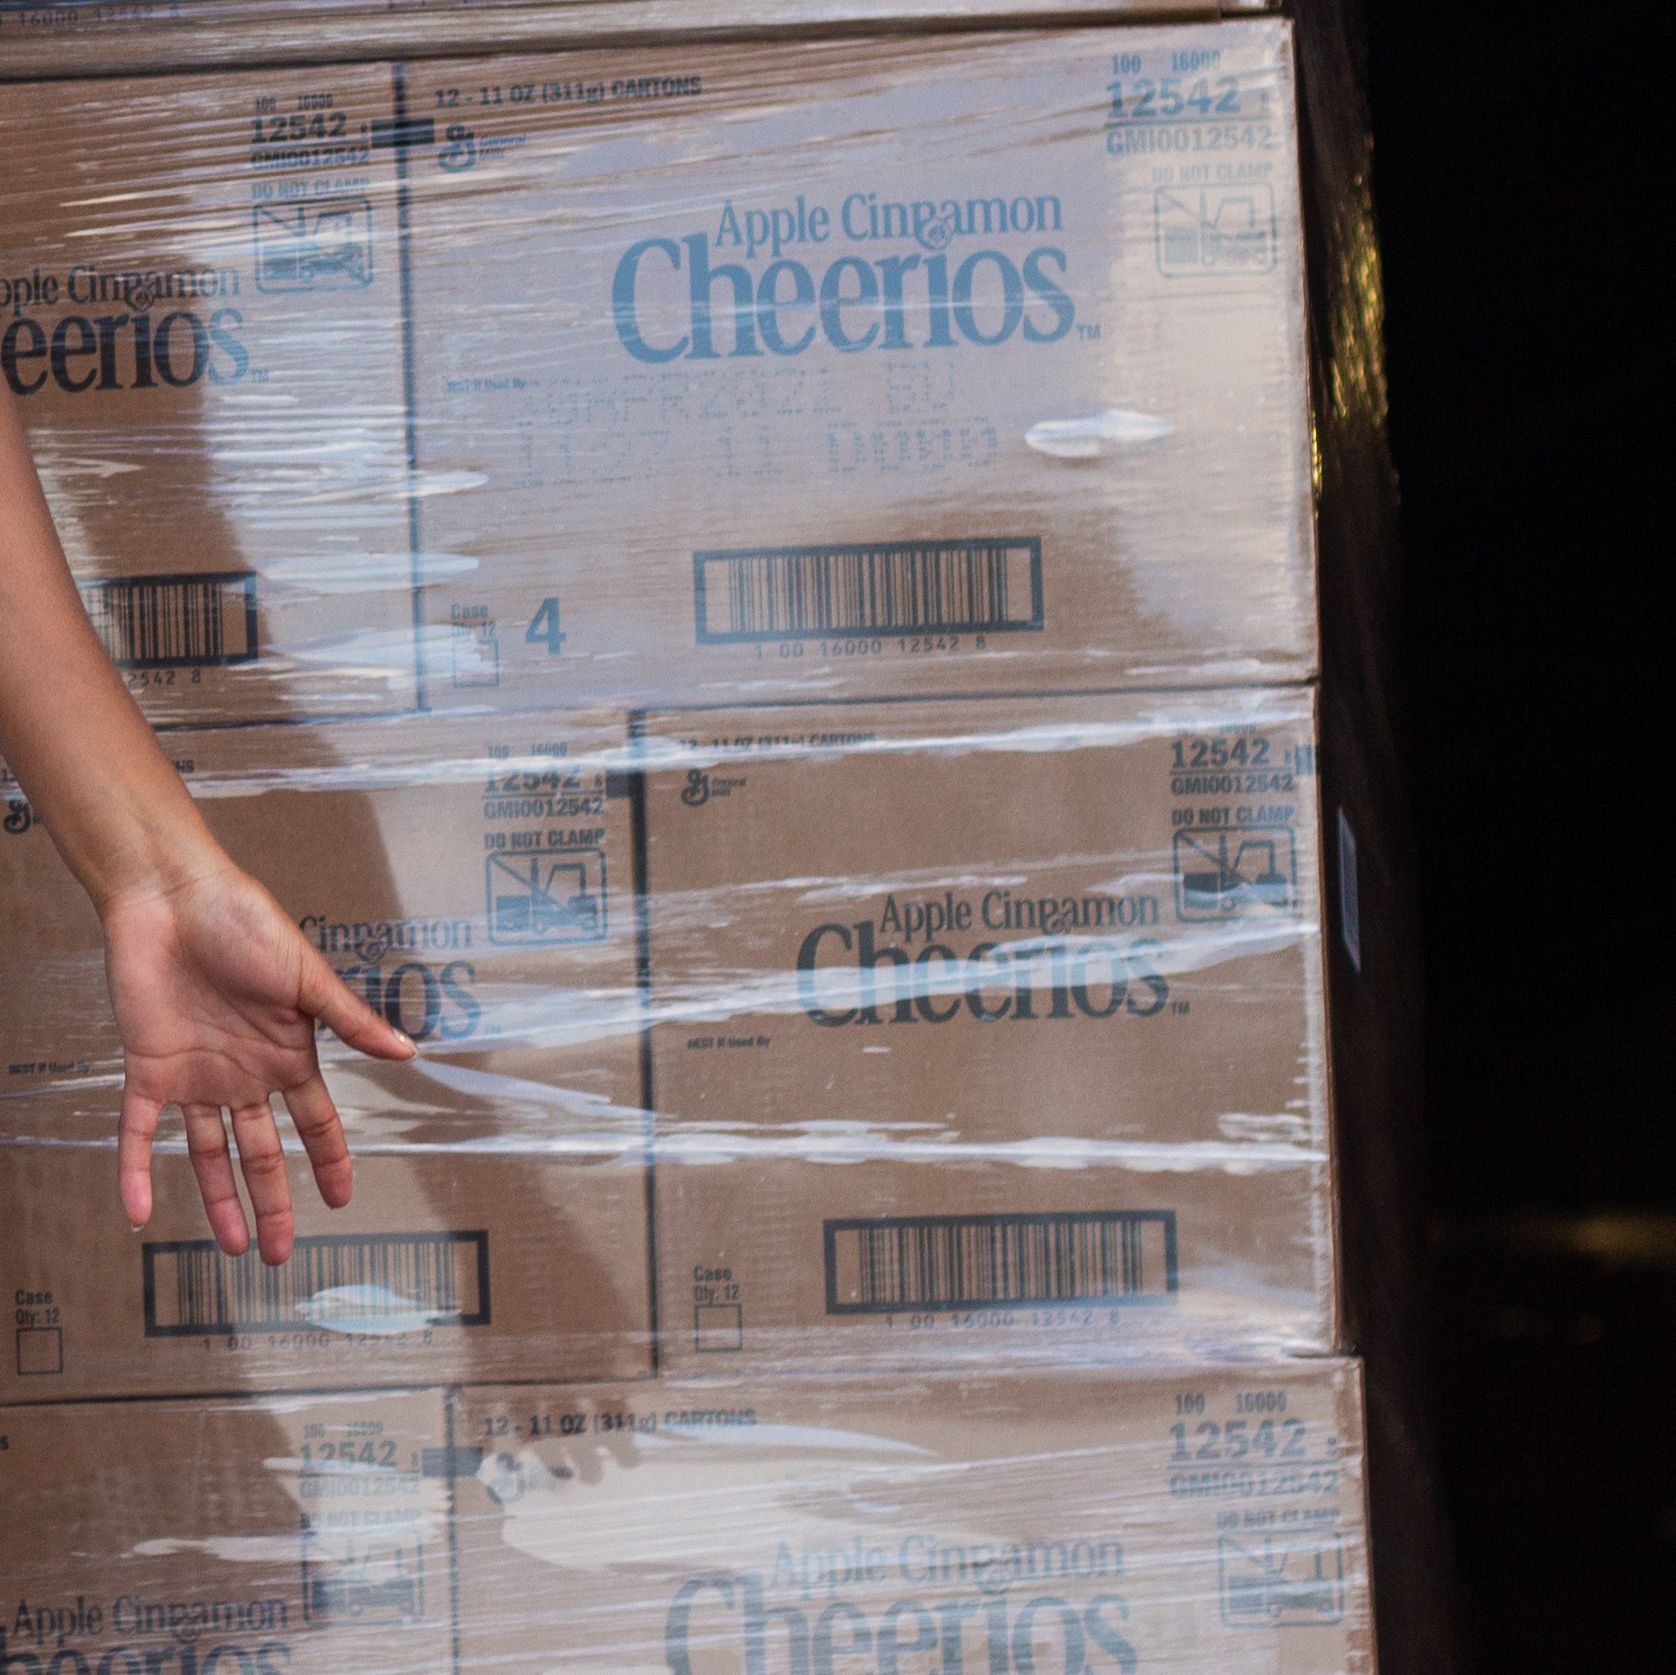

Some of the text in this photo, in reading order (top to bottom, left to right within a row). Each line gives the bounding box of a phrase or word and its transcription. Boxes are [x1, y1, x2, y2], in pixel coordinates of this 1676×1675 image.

[1113, 55, 1142, 74] 100
[435, 77, 702, 108] 12 11 OZ (311g) CARTONS
[1107, 76, 1241, 118] 12542
[250, 112, 347, 143] 12542
[1107, 125, 1275, 154] GMI0012542
[714, 190, 1064, 259] Apple Cinnamon
[67, 263, 241, 313] Cinnamon
[611, 231, 1077, 365] Cheerios
[450, 602, 489, 620] Case
[525, 595, 568, 655] 4
[1171, 738, 1270, 769] 12542
[1171, 775, 1294, 796] GMI0012542
[484, 799, 604, 820] GMI0012542
[1172, 805, 1294, 825] DO NOT CLAMP
[484, 827, 605, 850] DO NOT CLAMP
[878, 888, 1161, 938] Apple Cinnamon
[795, 921, 1172, 1029] Cheerios
[693, 1265, 733, 1283] Case
[15, 1289, 53, 1306] Case
[1176, 1391, 1287, 1415] 100 16000
[485, 1417, 510, 1437] 12
[530, 1416, 554, 1436] 11
[560, 1414, 587, 1434] OZ
[592, 1411, 657, 1436] (311g)
[1170, 1419, 1306, 1461] 12542
[300, 1441, 397, 1472] 12542
[767, 1533, 1125, 1594] Apple Cinnamon
[13, 1594, 289, 1645] Apple Cinnamon
